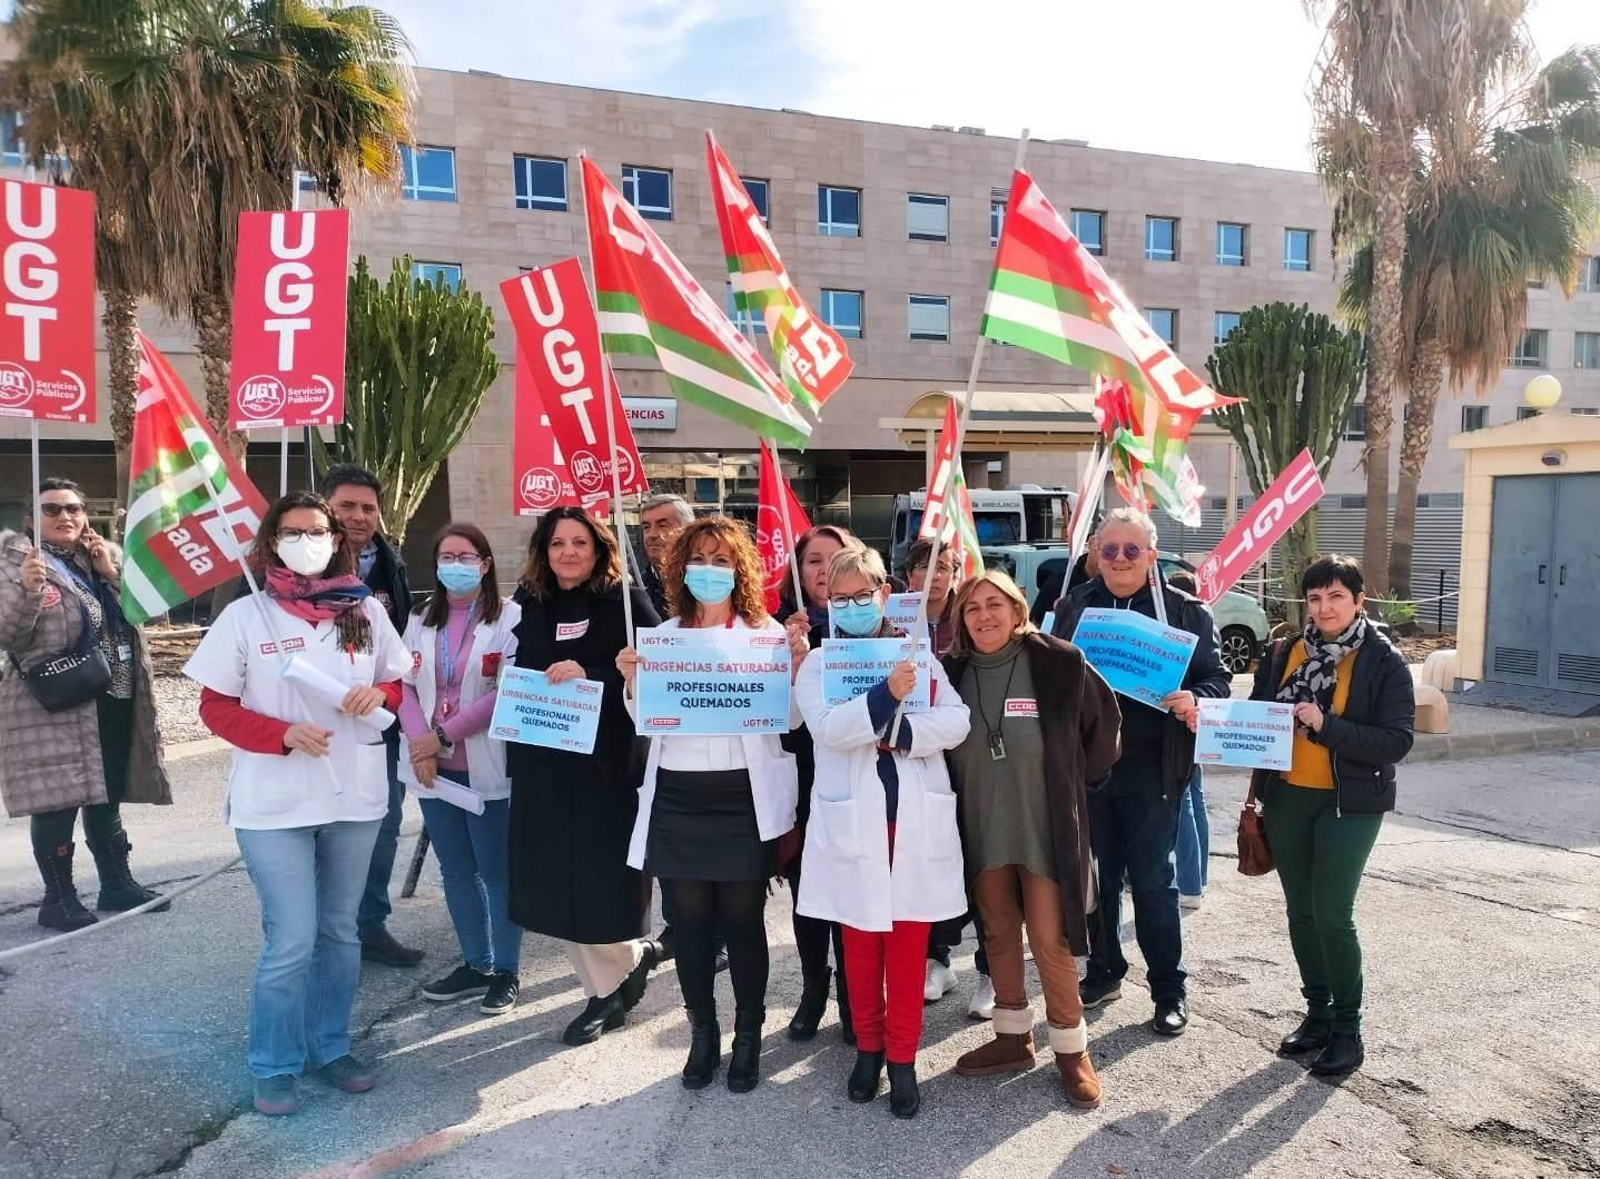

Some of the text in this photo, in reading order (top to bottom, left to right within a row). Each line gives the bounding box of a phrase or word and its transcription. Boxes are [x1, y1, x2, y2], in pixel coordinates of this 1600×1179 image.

[3, 182, 59, 362] UGT
[264, 212, 316, 371] UGT
[521, 269, 597, 445] UGT
[35, 380, 79, 391] Servicios
[244, 383, 279, 401] UGT
[287, 387, 327, 396] Servicios
[35, 388, 76, 399] Públicos
[287, 395, 324, 405] Públicos
[574, 457, 597, 478] UGT
[525, 475, 555, 491] UGT
[1223, 462, 1318, 567] UGT
[642, 637, 661, 645] UGT
[1076, 631, 1187, 663] URGENCIAS SATURADAS
[1087, 645, 1163, 672] PROFESIONALES
[643, 661, 789, 674] URGENCIAS SATURADAS
[825, 662, 875, 670] URGENCIAS
[1093, 657, 1148, 678] QUEMADOS
[667, 682, 765, 693] PROFESIONALES
[502, 688, 598, 712] URGENCIAS SATURADAS
[680, 697, 751, 709] QUEMADOS
[1008, 702, 1038, 711] CCOO
[515, 704, 581, 723] PROFESIONALES
[521, 717, 570, 732] QUEMADOS
[743, 719, 762, 727] UGT
[1201, 719, 1292, 732] URGENCIAS SATURADAS
[1214, 732, 1276, 743] PROFESIONALES
[1222, 742, 1267, 752] QUEMADOS
